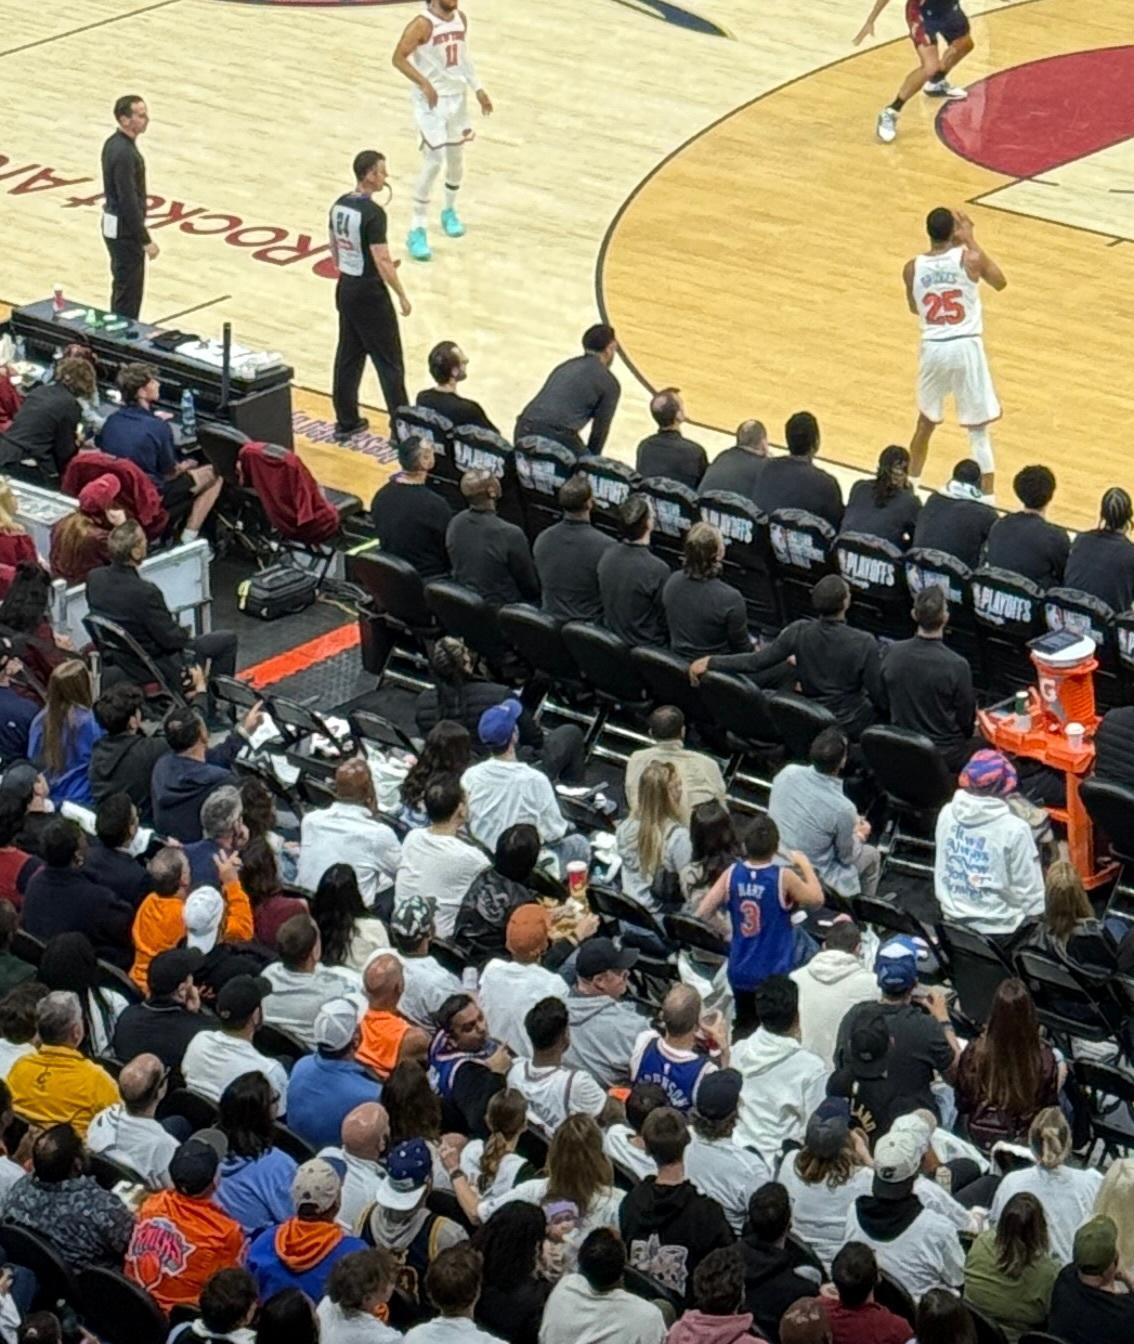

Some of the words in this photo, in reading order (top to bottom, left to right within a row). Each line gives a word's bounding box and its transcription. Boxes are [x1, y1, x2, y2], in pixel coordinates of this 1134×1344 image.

[444, 43, 459, 70] 11
[922, 288, 966, 326] 25
[848, 553, 896, 588] PLAYOFFS
[982, 582, 1032, 623] PLAYOFFS
[1040, 677, 1057, 702] G
[737, 882, 766, 900] HART
[739, 899, 761, 939] 3
